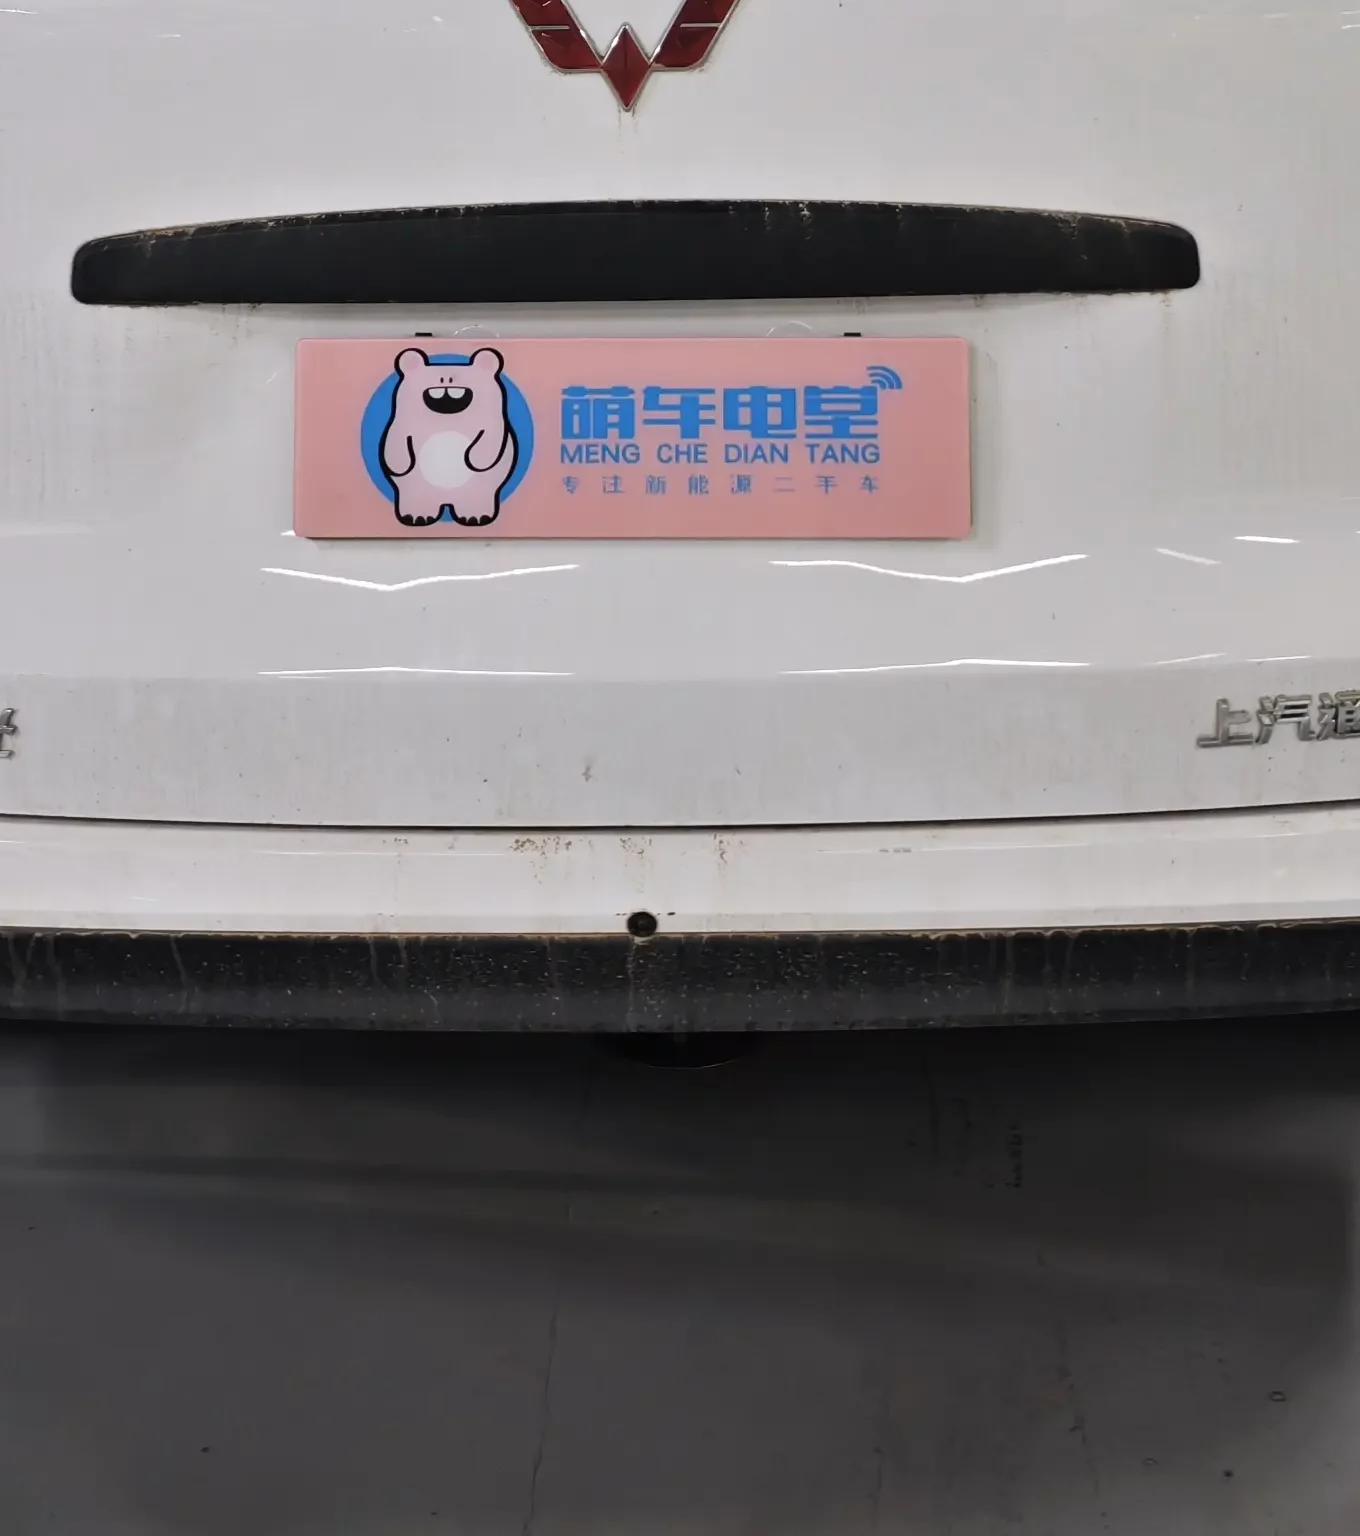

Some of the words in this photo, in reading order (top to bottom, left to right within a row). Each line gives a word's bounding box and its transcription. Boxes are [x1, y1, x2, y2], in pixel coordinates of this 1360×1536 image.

[560, 385, 879, 440] 萌车电堂
[560, 443, 641, 465] MENG
[656, 443, 708, 465] CHE
[724, 443, 789, 465] DIAN
[805, 443, 880, 465] TANG
[561, 474, 880, 495] 专注新能源二手车
